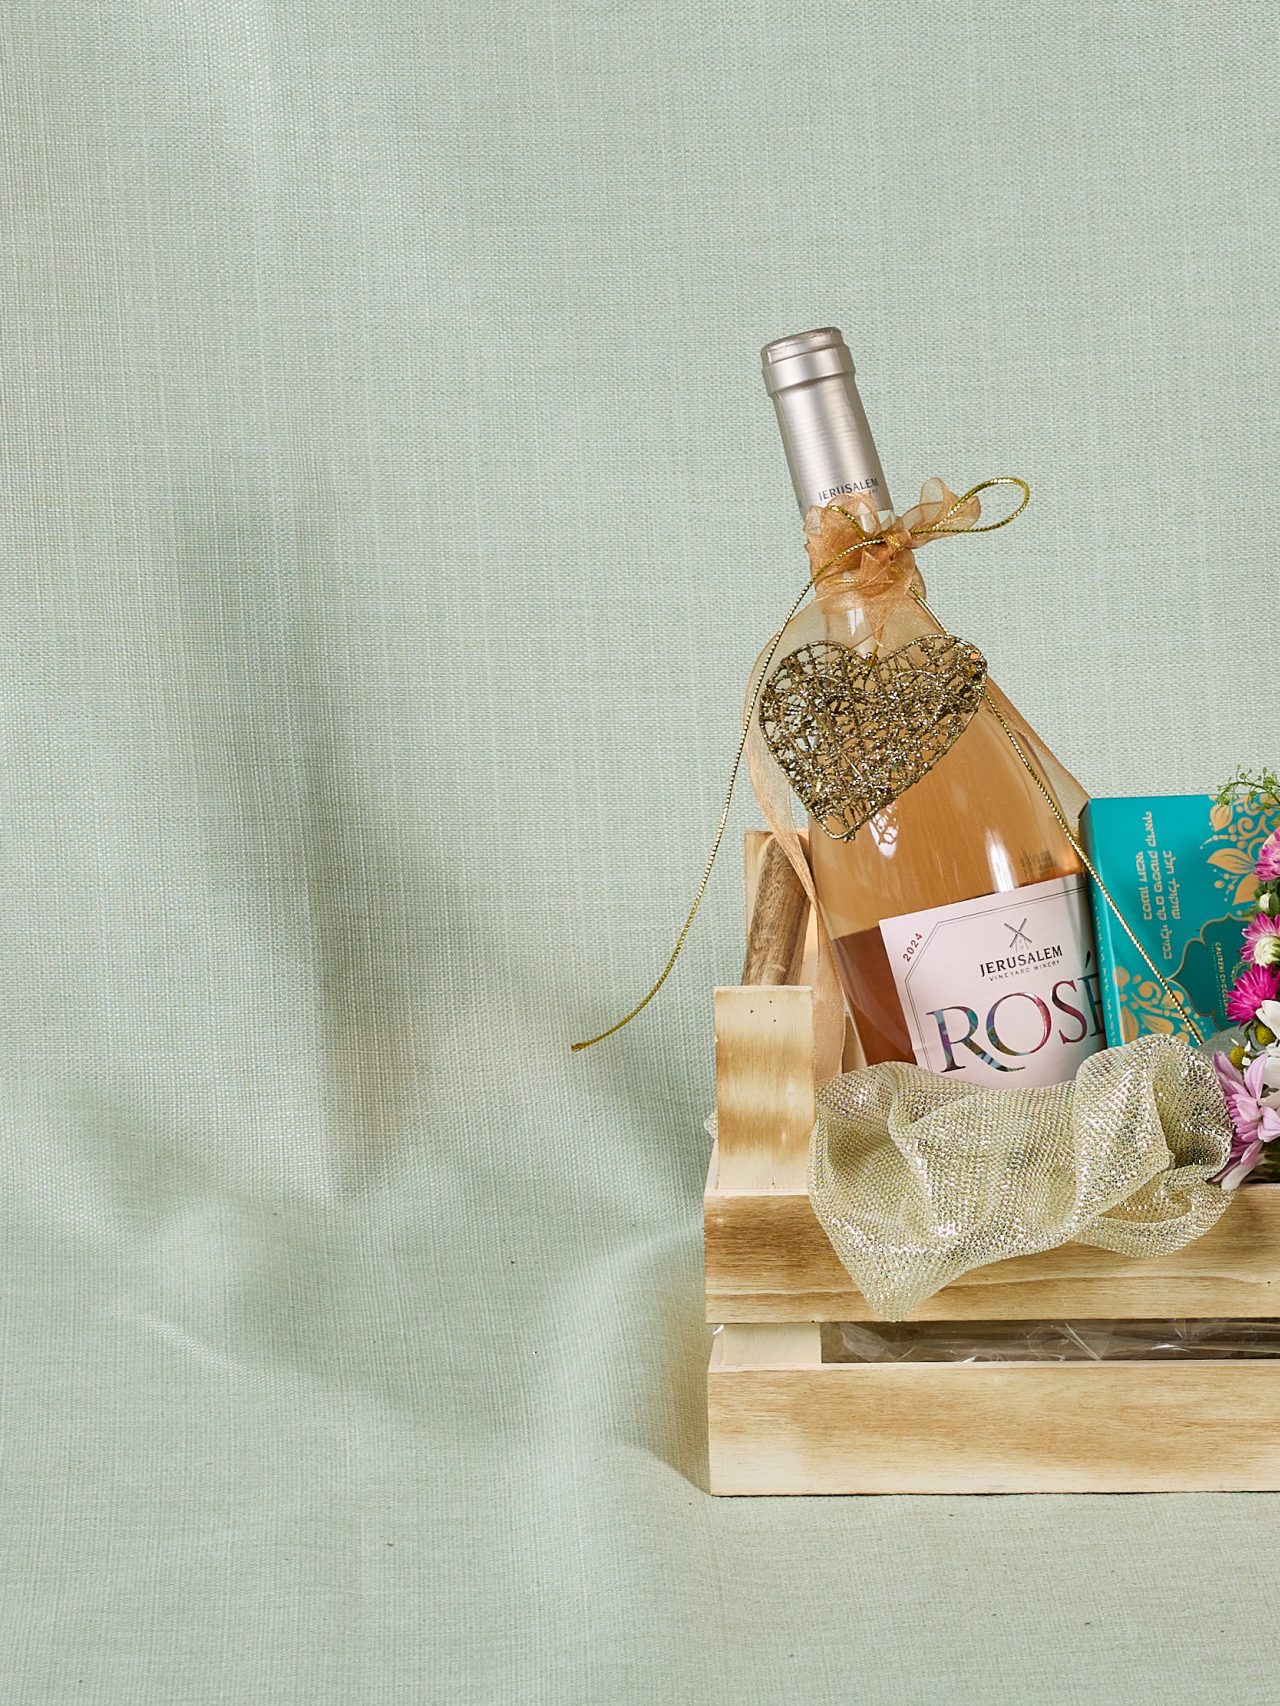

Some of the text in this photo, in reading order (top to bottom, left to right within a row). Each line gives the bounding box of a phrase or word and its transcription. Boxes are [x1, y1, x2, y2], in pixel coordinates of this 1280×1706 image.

[818, 478, 879, 501] JERUSALEM
[1148, 850, 1163, 893] פיסטוק
[1163, 850, 1182, 920] שוקולד חלב
[1138, 885, 1152, 921] בסגנון
[1156, 896, 1168, 921] קרם
[902, 932, 923, 962] 2024
[979, 944, 1063, 977] JERUSALEM
[988, 960, 1061, 982] VINEYARD WINERY
[926, 950, 1106, 1073] ROSÉ
